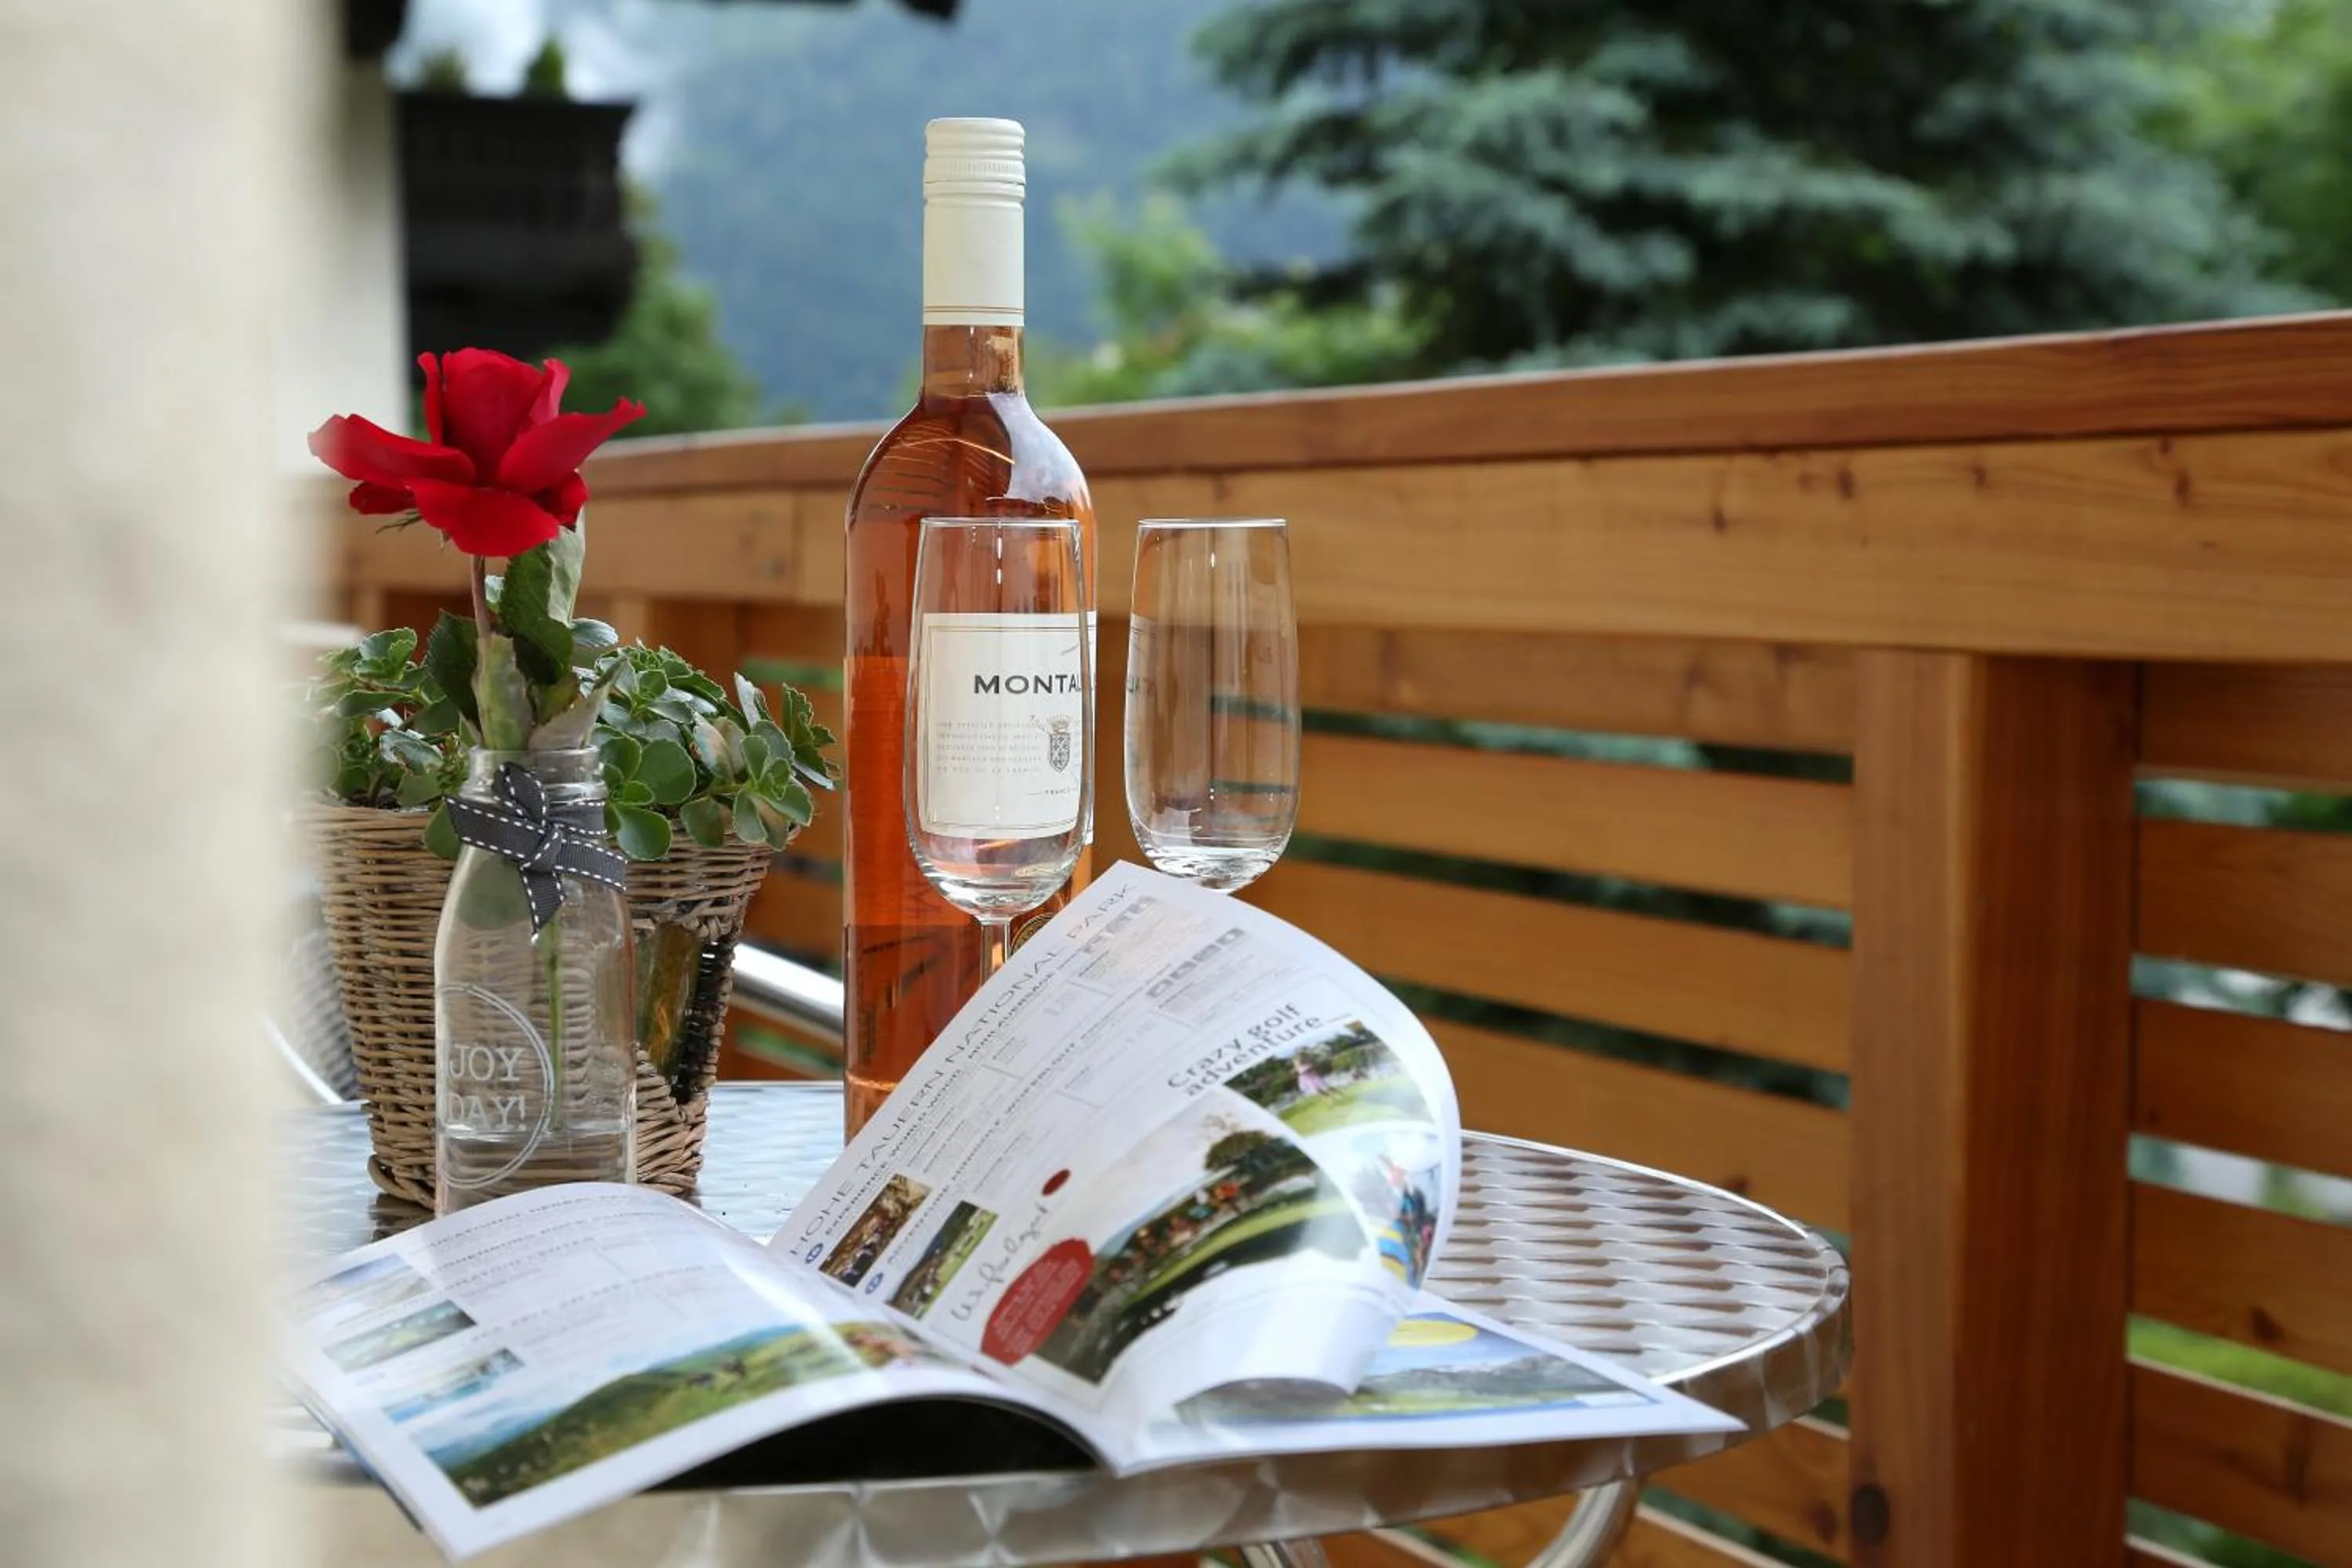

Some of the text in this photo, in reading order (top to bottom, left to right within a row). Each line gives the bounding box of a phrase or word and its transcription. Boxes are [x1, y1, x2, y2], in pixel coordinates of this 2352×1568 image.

[449, 1043, 526, 1081] JOY
[789, 1179, 856, 1255] HOHE
[855, 1069, 945, 1173] TAUERN
[945, 943, 1069, 1064] NATIONAL
[1065, 883, 1132, 938] PARK
[1167, 1002, 1301, 1089] Crazy golf
[1185, 1016, 1325, 1097] adventure
[447, 1091, 527, 1131] DAY!
[825, 1161, 889, 1236] EXPERIENCE
